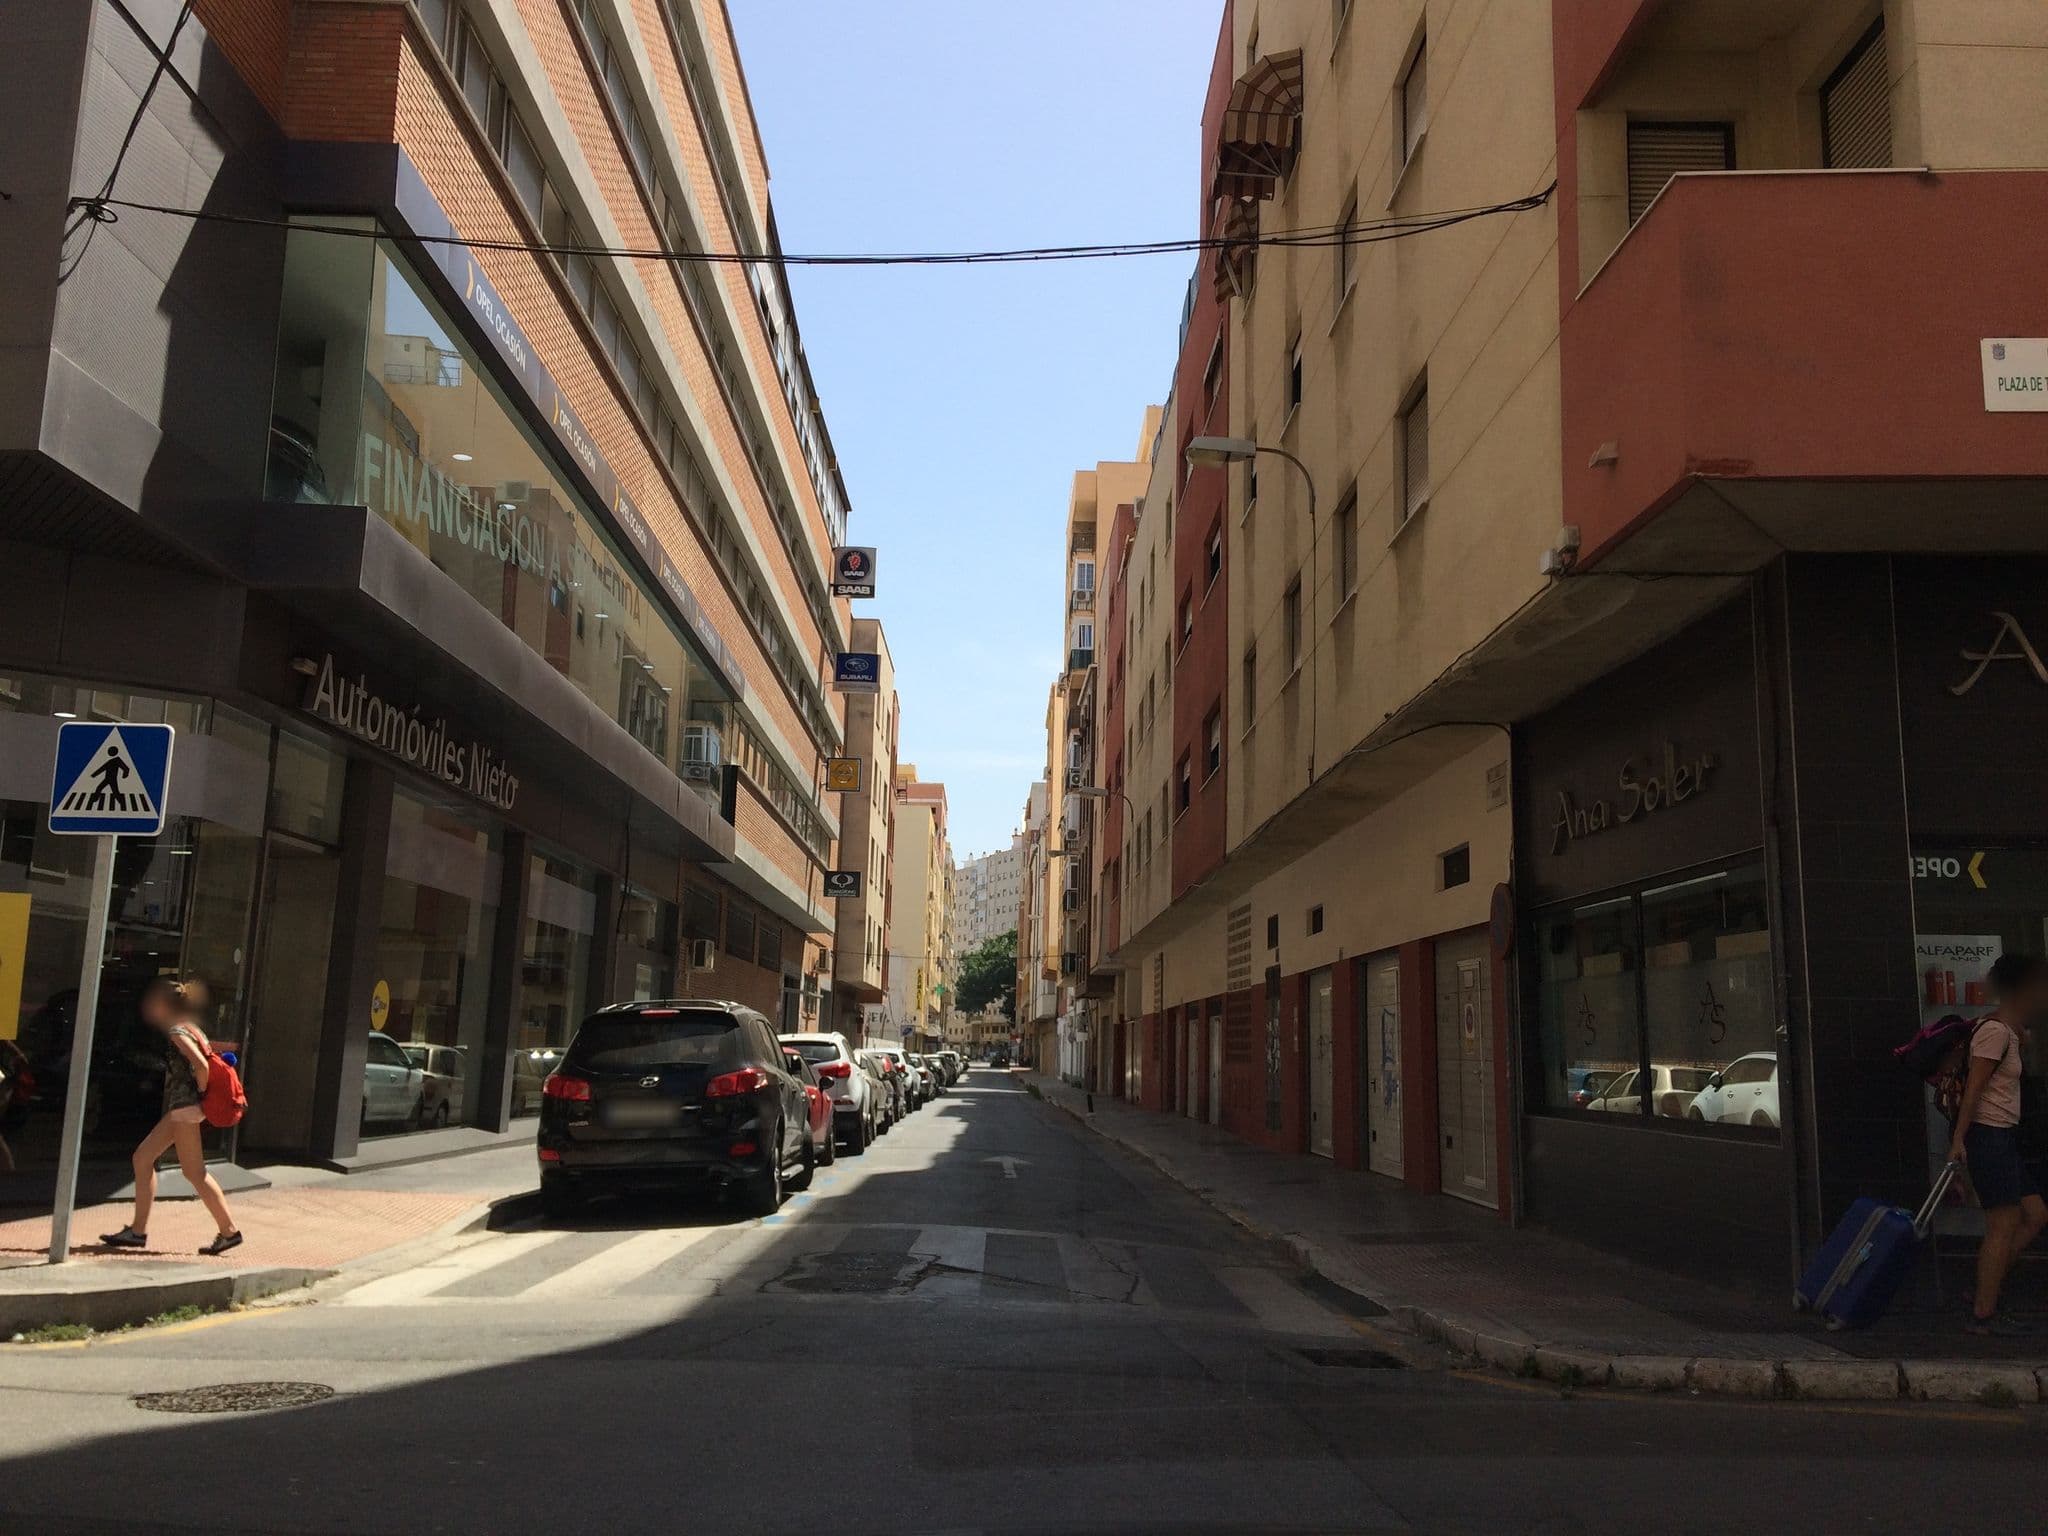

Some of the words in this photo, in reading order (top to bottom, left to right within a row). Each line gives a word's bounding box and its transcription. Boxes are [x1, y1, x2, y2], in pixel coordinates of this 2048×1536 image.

[475, 283, 494, 325] OPEL
[495, 313, 527, 373] OCASIÓN
[1998, 376, 2028, 392] PLAZA
[2030, 376, 2043, 391] DE
[559, 409, 573, 441] OPEL
[573, 430, 597, 474] OCASIÓN
[363, 432, 545, 577] FINANCIACION
[837, 585, 871, 595] SAAB
[312, 652, 465, 785] Automóviles
[468, 741, 519, 810] Nieto
[1551, 785, 1610, 857] Ana
[1616, 736, 1716, 824] Soler
[1916, 945, 1994, 956] ALFAPARF
